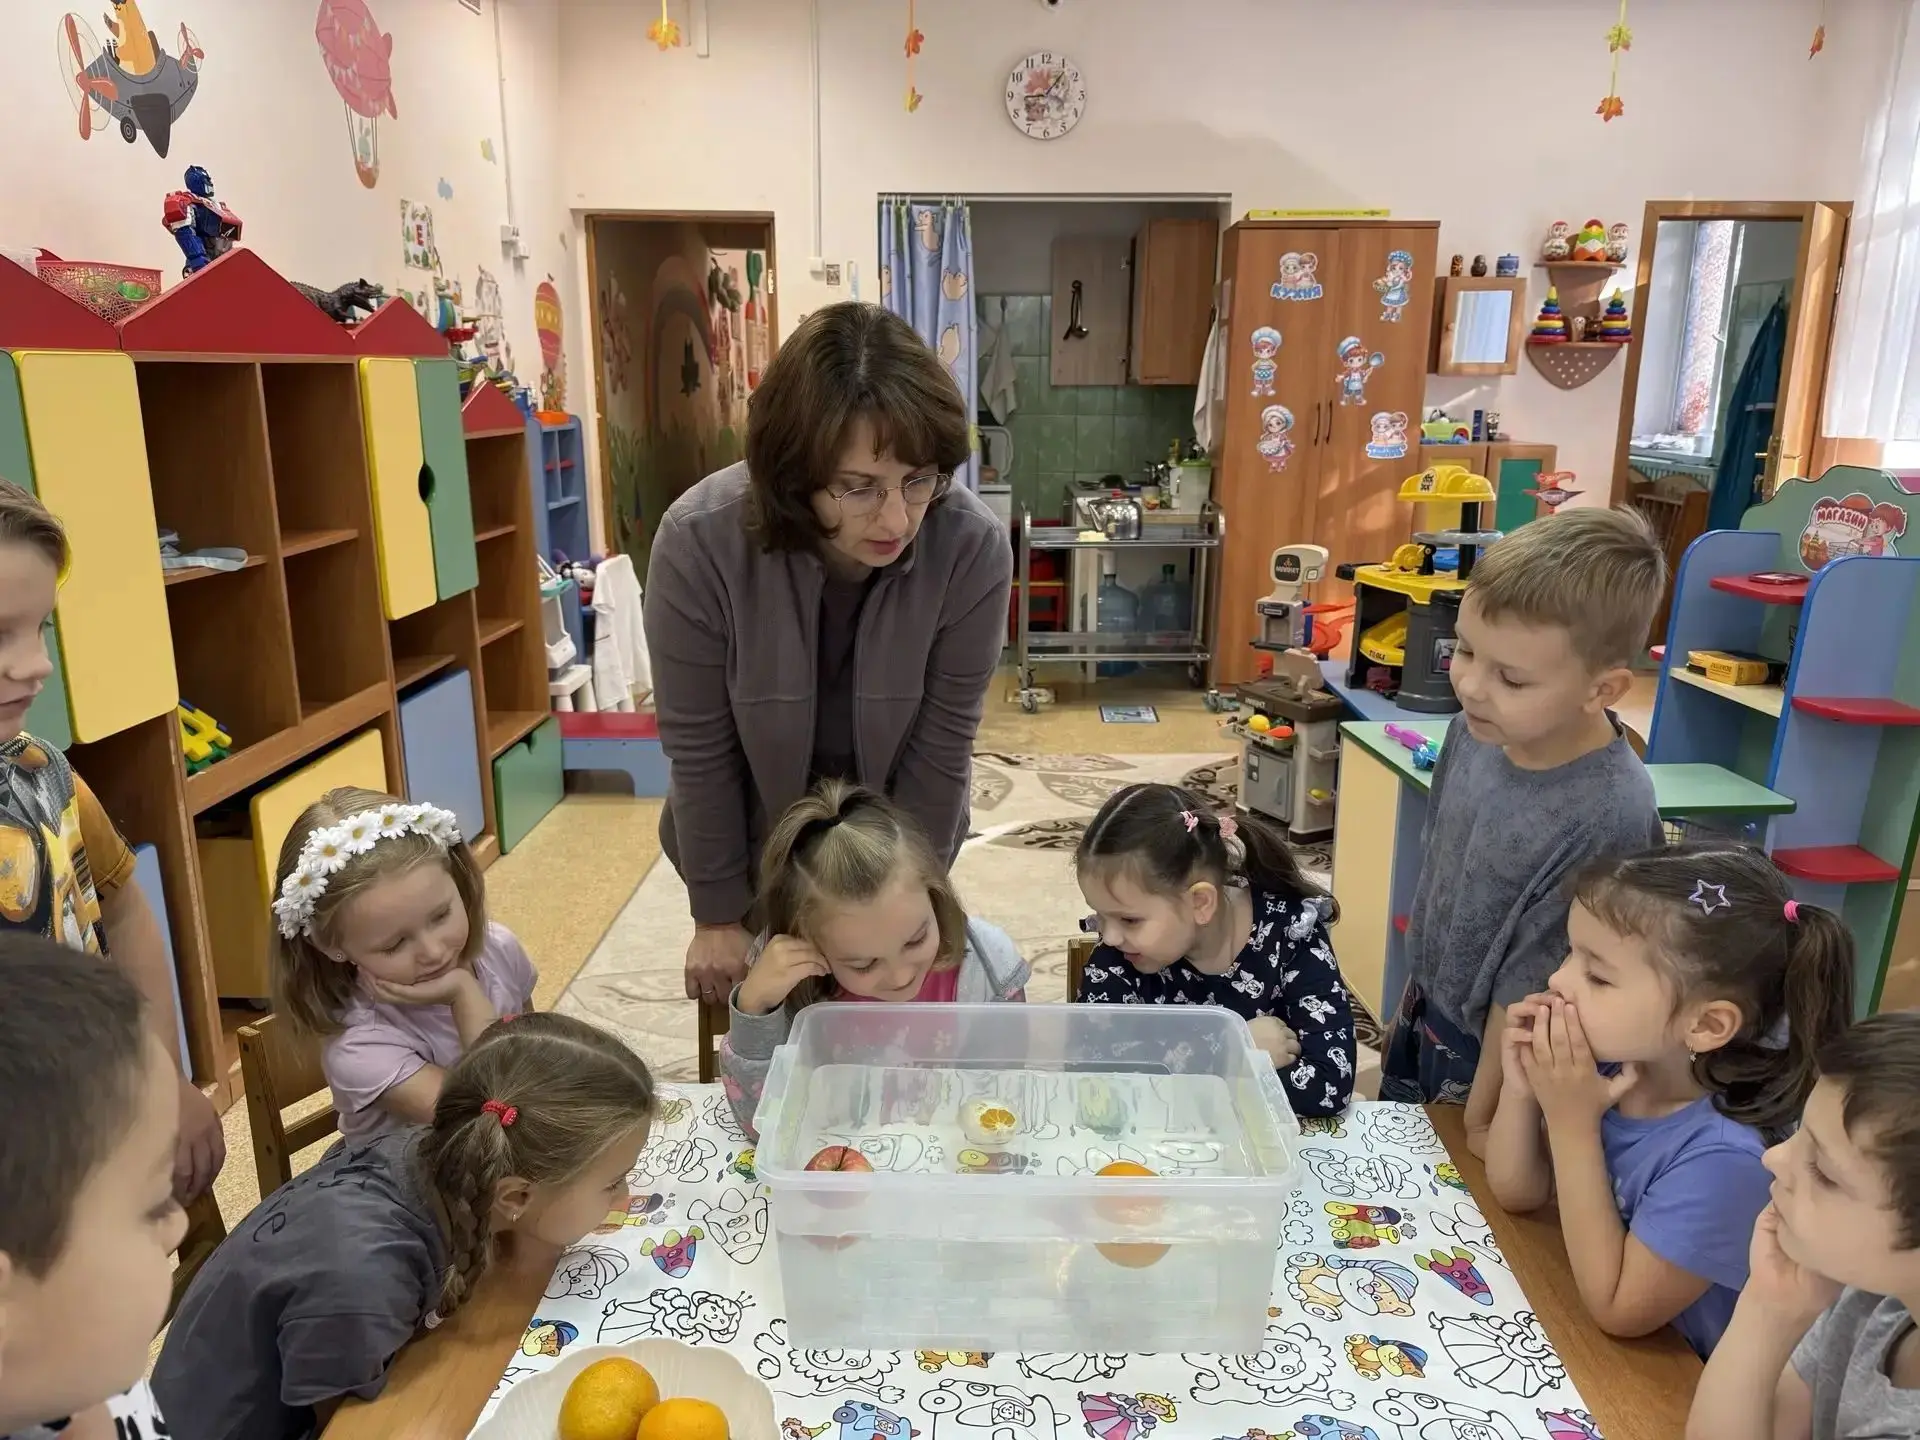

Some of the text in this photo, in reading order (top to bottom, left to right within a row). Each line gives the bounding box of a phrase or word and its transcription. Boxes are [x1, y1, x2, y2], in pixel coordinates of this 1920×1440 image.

[1026, 58, 1034, 68] 11
[1041, 53, 1052, 64] 12
[1011, 72, 1023, 82] 10
[1072, 72, 1079, 82] 2
[1007, 91, 1014, 101] 9
[1043, 128, 1050, 138] 6
[1272, 285, 1322, 298] КУХНЯ
[1817, 508, 1867, 531] МАГАЗИН
